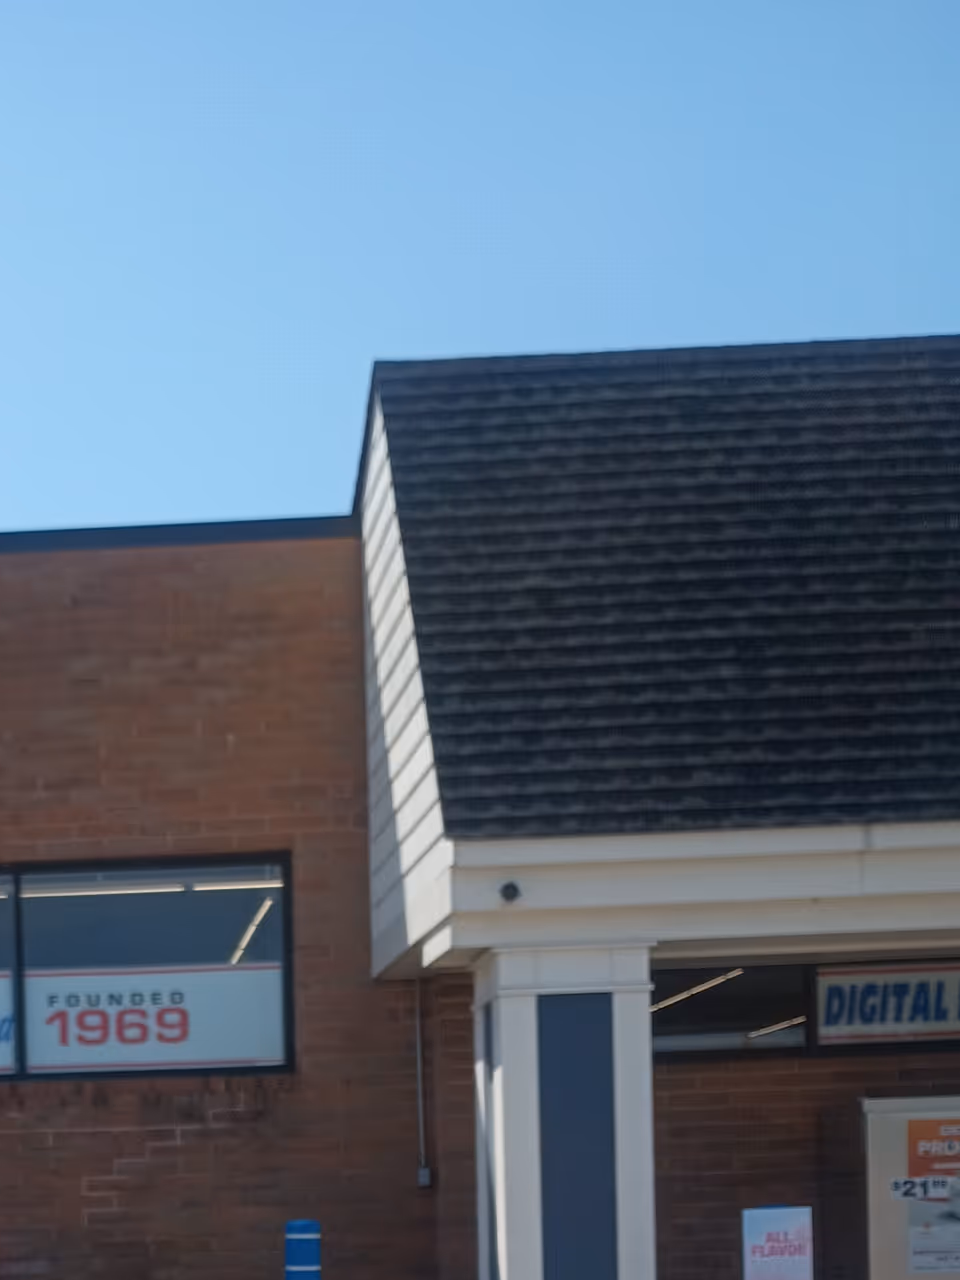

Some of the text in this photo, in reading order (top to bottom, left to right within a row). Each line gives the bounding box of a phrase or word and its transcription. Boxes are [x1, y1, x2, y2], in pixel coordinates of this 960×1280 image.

[47, 991, 185, 1008] FOUNDED
[824, 981, 948, 1026] DIGITAL
[45, 1007, 189, 1047] 1969
[918, 1139, 960, 1157] PRO
